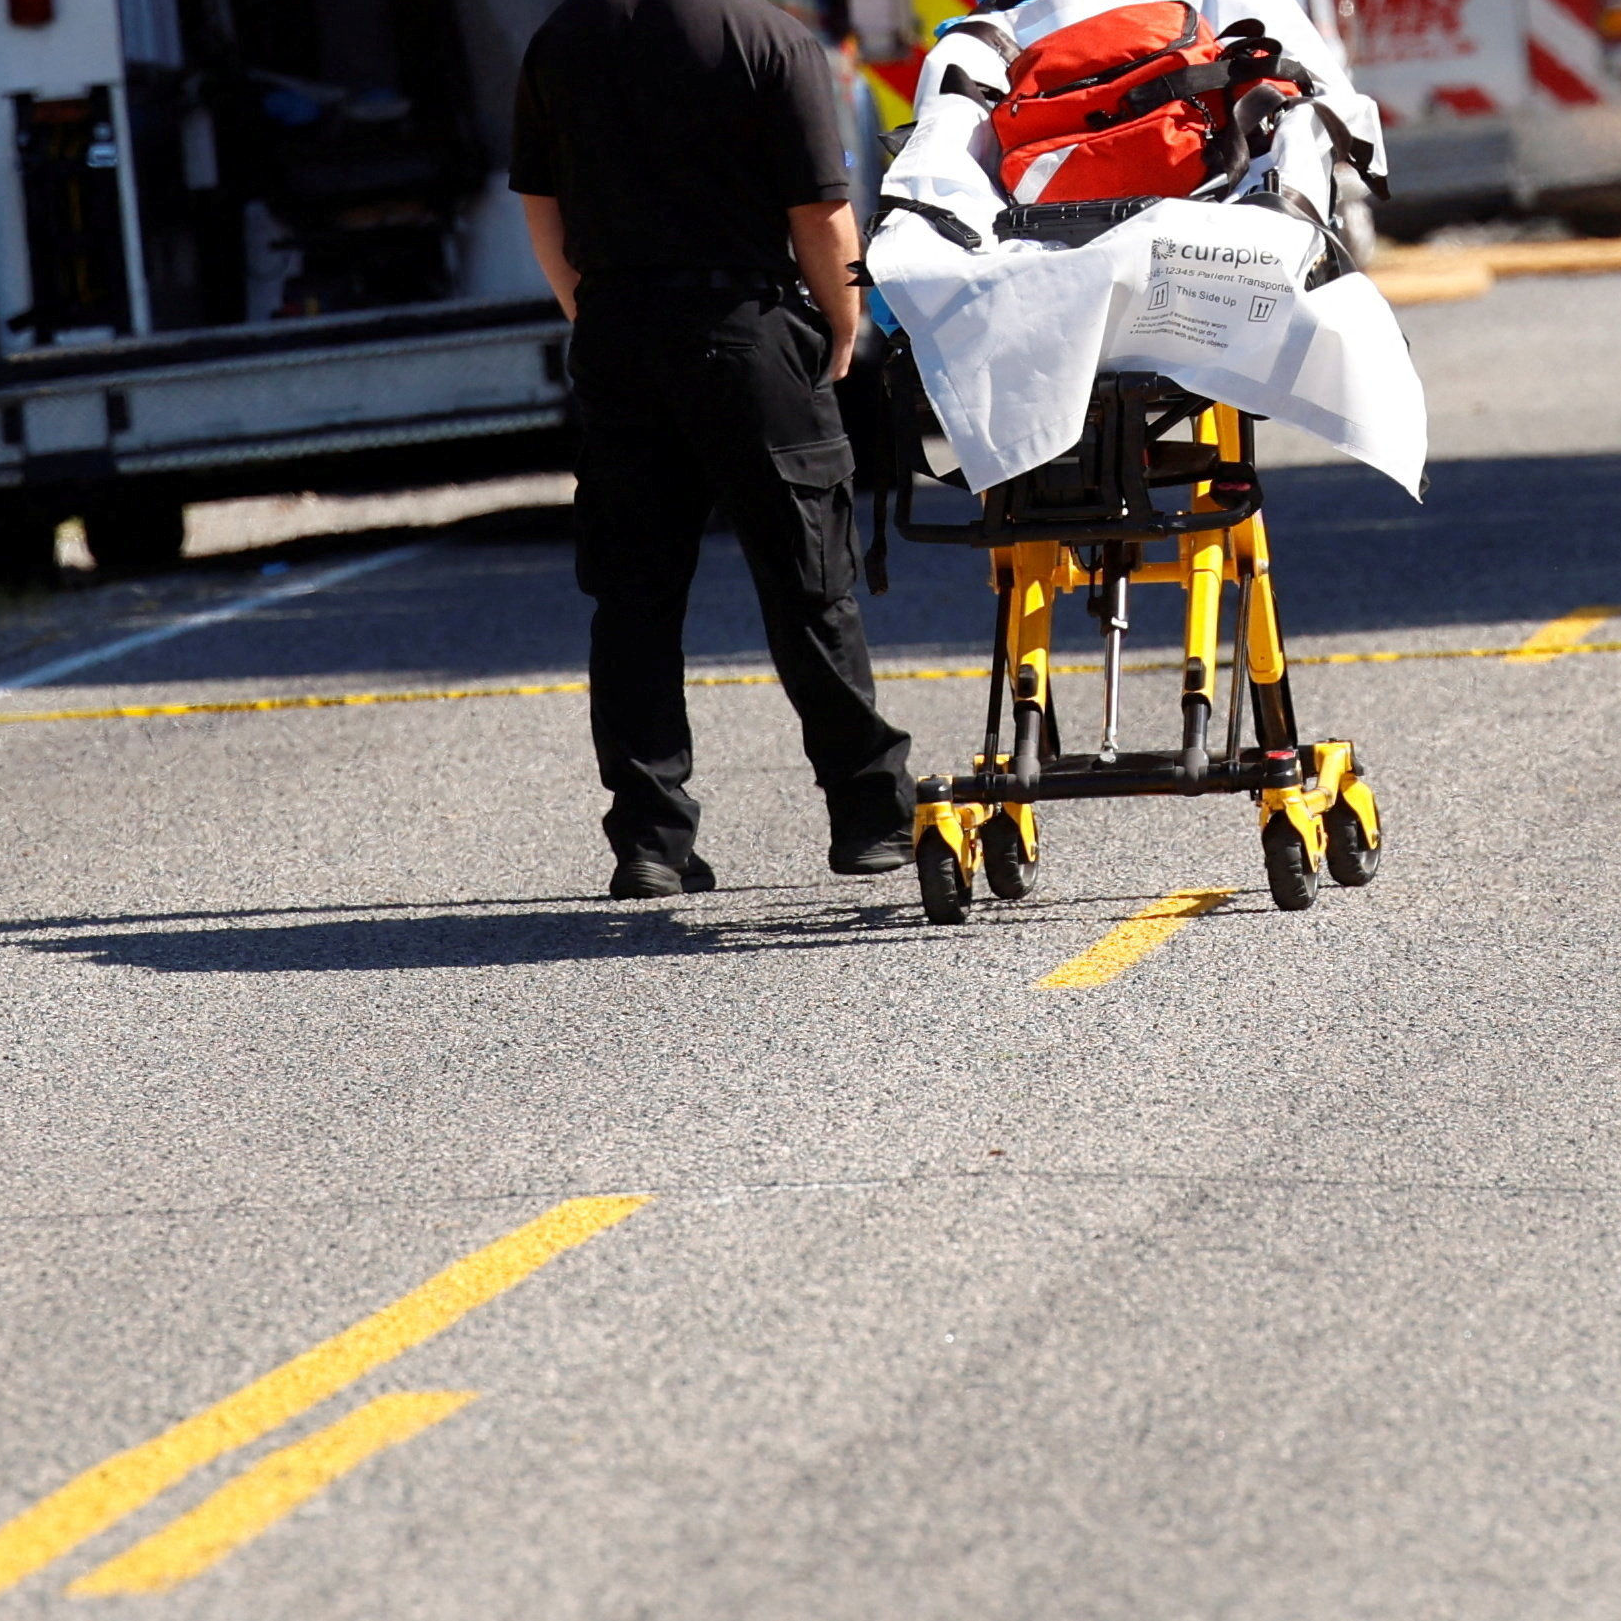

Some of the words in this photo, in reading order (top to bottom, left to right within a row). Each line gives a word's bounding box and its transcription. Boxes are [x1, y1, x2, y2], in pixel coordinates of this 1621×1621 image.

[1197, 269, 1236, 283] Patient
[1176, 285, 1197, 299] This
[1198, 289, 1222, 304] Side
[1222, 295, 1238, 308] Up
[1174, 311, 1211, 328] excessively
[1174, 330, 1187, 339] with
[1187, 333, 1206, 345] sharp
[1181, 323, 1198, 332] wash
[1206, 329, 1218, 338] dry
